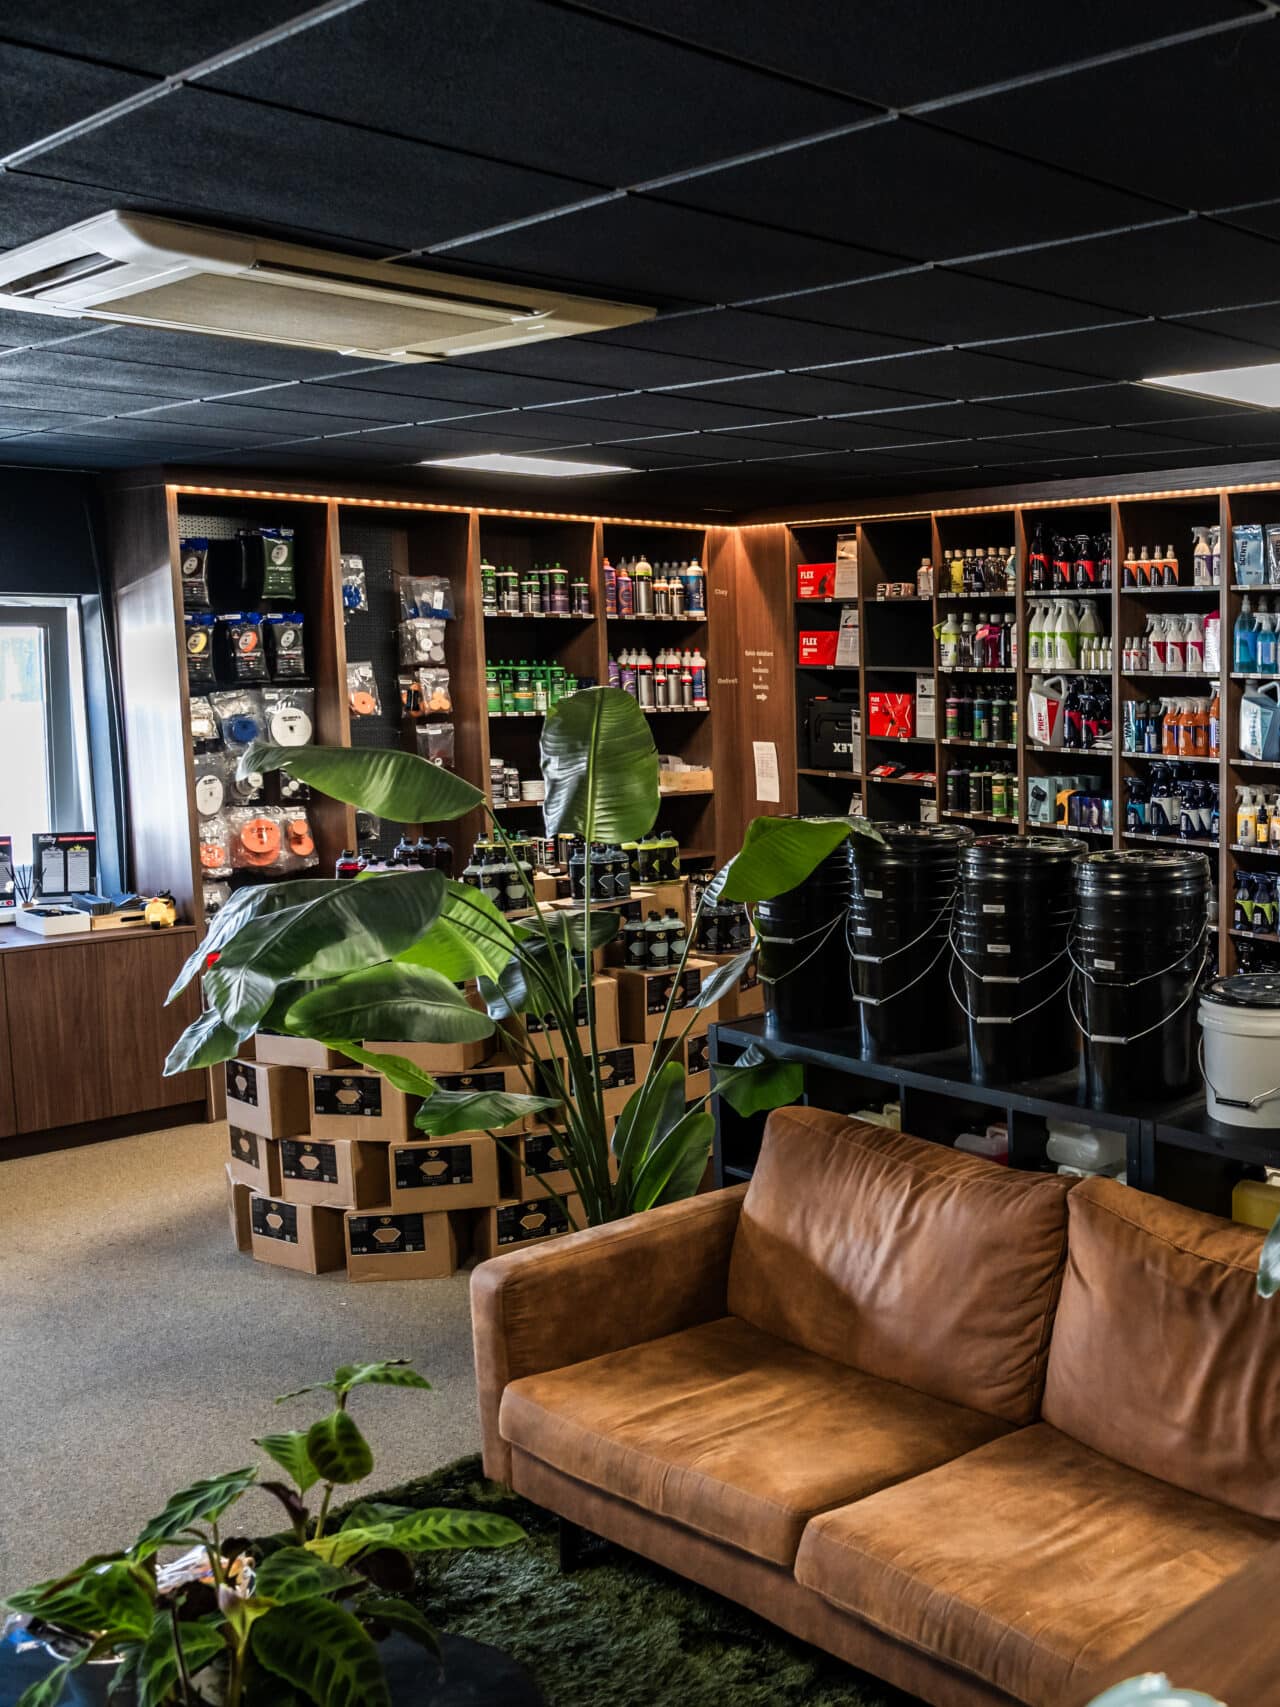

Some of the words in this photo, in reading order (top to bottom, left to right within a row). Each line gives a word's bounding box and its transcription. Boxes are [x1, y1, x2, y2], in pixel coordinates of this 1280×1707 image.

[1239, 540, 1248, 566] SCENTS
[800, 571, 814, 579] FLEX
[802, 637, 817, 646] FLEX
[1037, 711, 1045, 732] PREP
[832, 742, 853, 753] LEX
